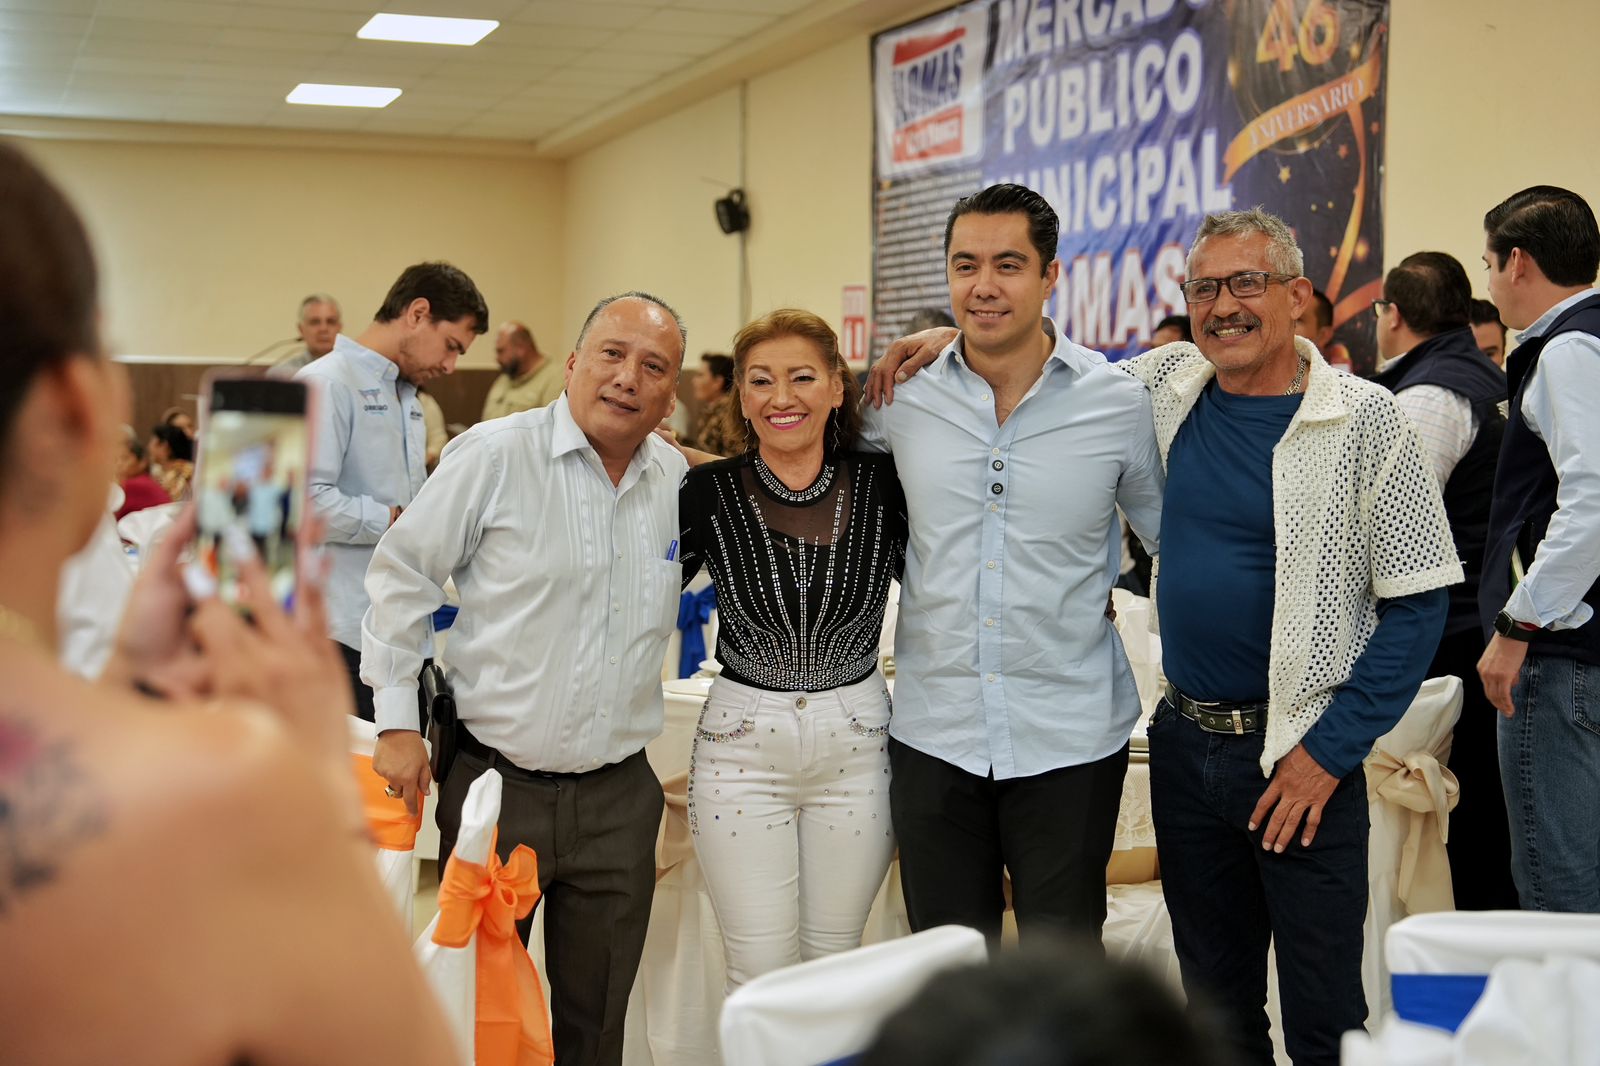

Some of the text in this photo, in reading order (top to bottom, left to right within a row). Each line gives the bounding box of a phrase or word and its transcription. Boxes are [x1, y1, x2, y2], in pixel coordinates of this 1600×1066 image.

[1256, 0, 1341, 72] 46
[1004, 31, 1202, 153] PÚBLICO
[983, 133, 1233, 234] NICIPAL
